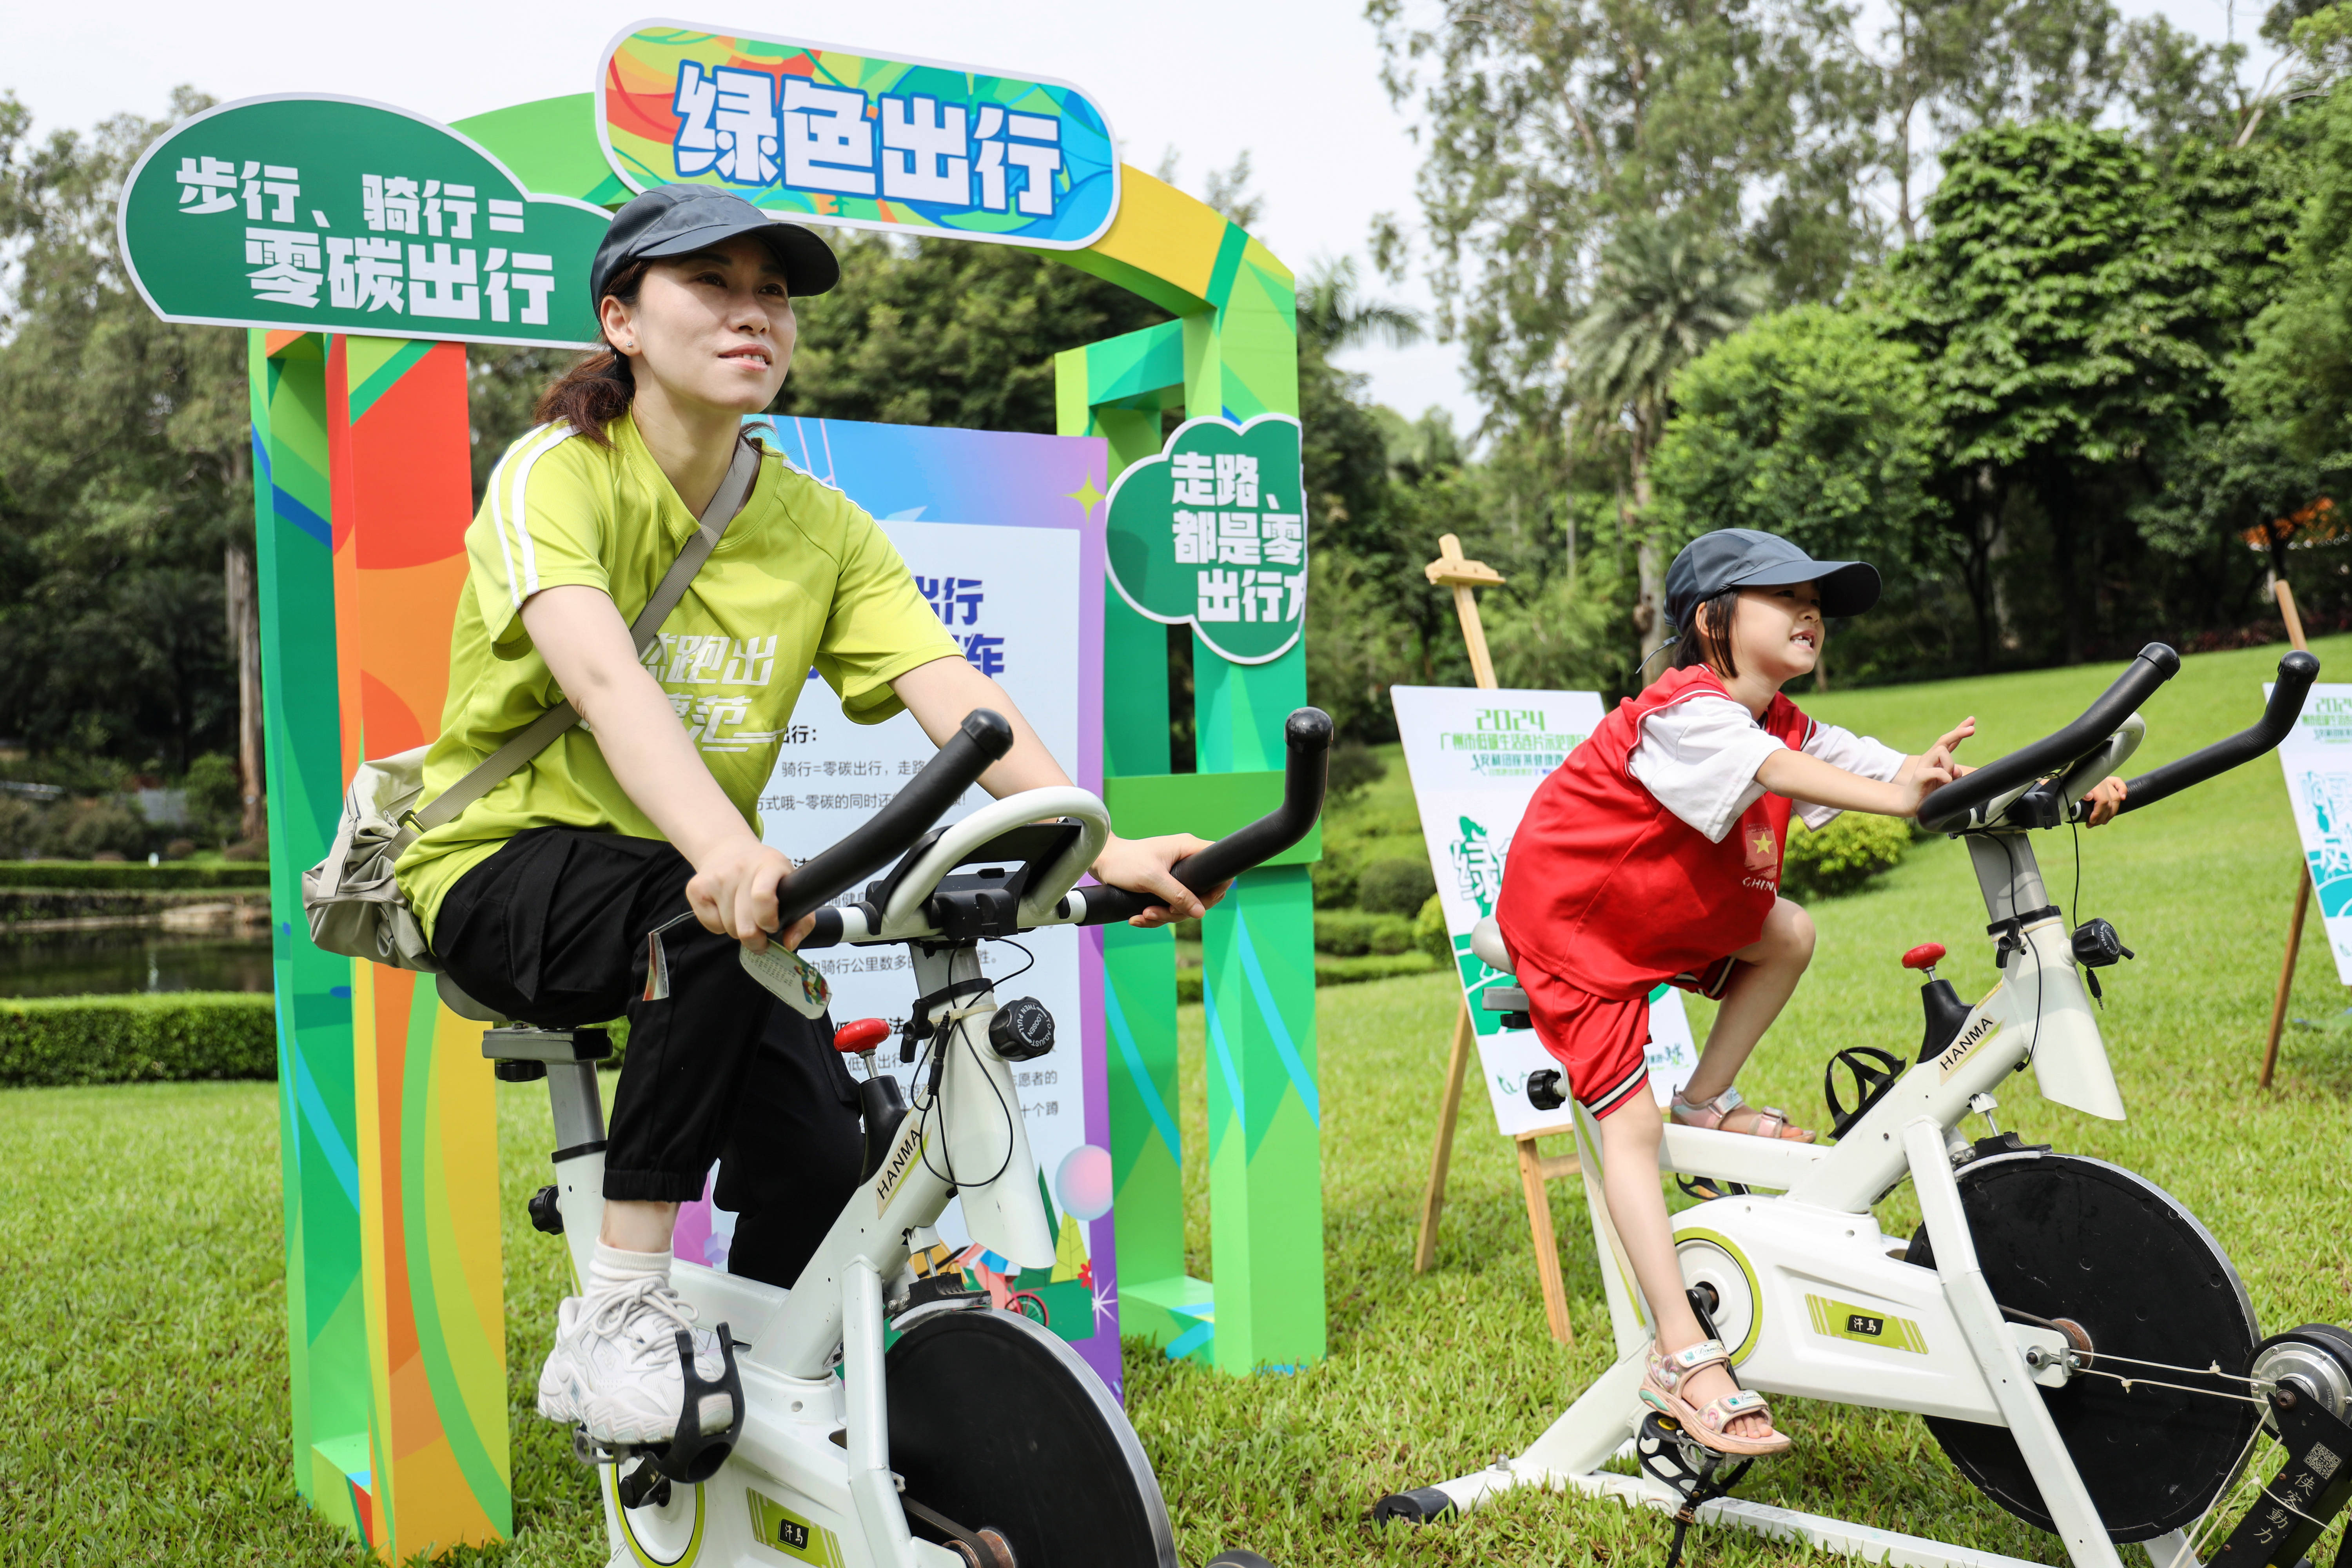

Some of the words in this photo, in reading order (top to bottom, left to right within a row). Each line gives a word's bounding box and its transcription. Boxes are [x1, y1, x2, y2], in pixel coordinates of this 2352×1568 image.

[676, 62, 1062, 216] 绿色出行
[245, 226, 555, 325] 零碳出行
[1171, 452, 1280, 510] 走路、
[1172, 510, 1303, 565] 都是零
[1475, 708, 1546, 731] 2024
[1452, 838, 1512, 904] 绿
[1742, 877, 1777, 895] CHIN
[1020, 1004, 1037, 1014] THEN
[1027, 1013, 1043, 1037] LOOSEN
[1045, 1018, 1052, 1029] TO
[1031, 1030, 1051, 1047] ADJUST
[1940, 1018, 1994, 1071] HANMA
[877, 1129, 921, 1200] HANMA
[1853, 1317, 1877, 1333] 汗马
[784, 1523, 803, 1545] 汗马
